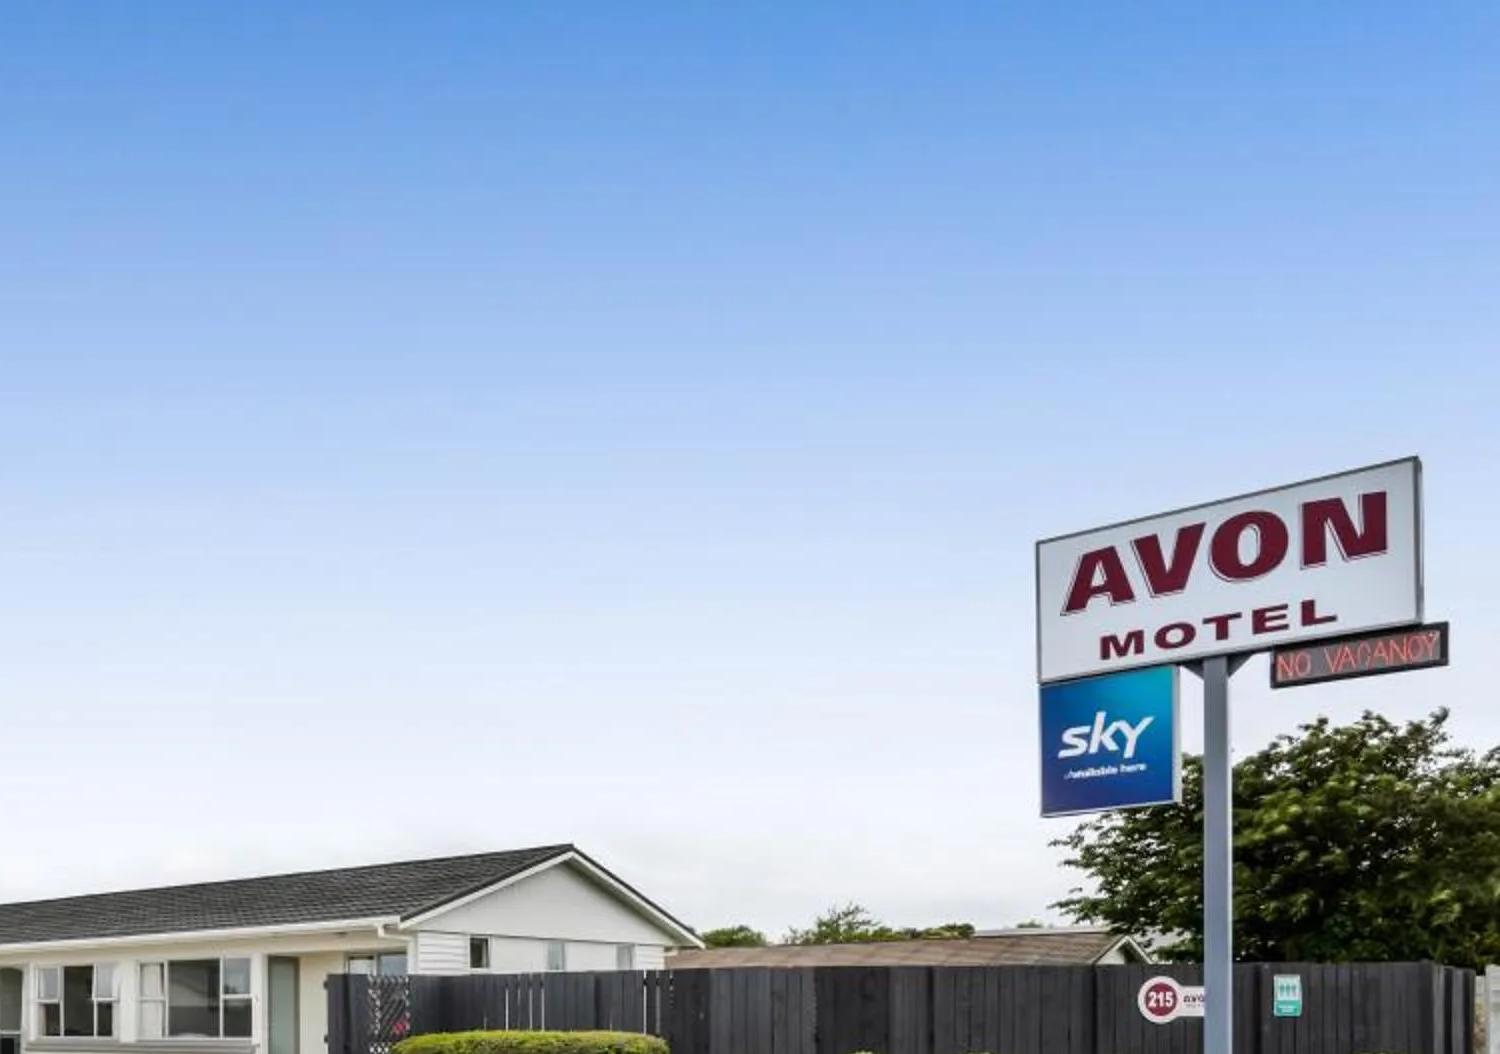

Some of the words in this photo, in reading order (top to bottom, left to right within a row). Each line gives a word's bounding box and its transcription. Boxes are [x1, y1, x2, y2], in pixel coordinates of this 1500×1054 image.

[1060, 491, 1388, 616] AVON
[1100, 599, 1338, 660] MOTEL
[1276, 651, 1312, 679] NO
[1324, 632, 1439, 673] VACANCY
[1148, 991, 1174, 1008] 215
